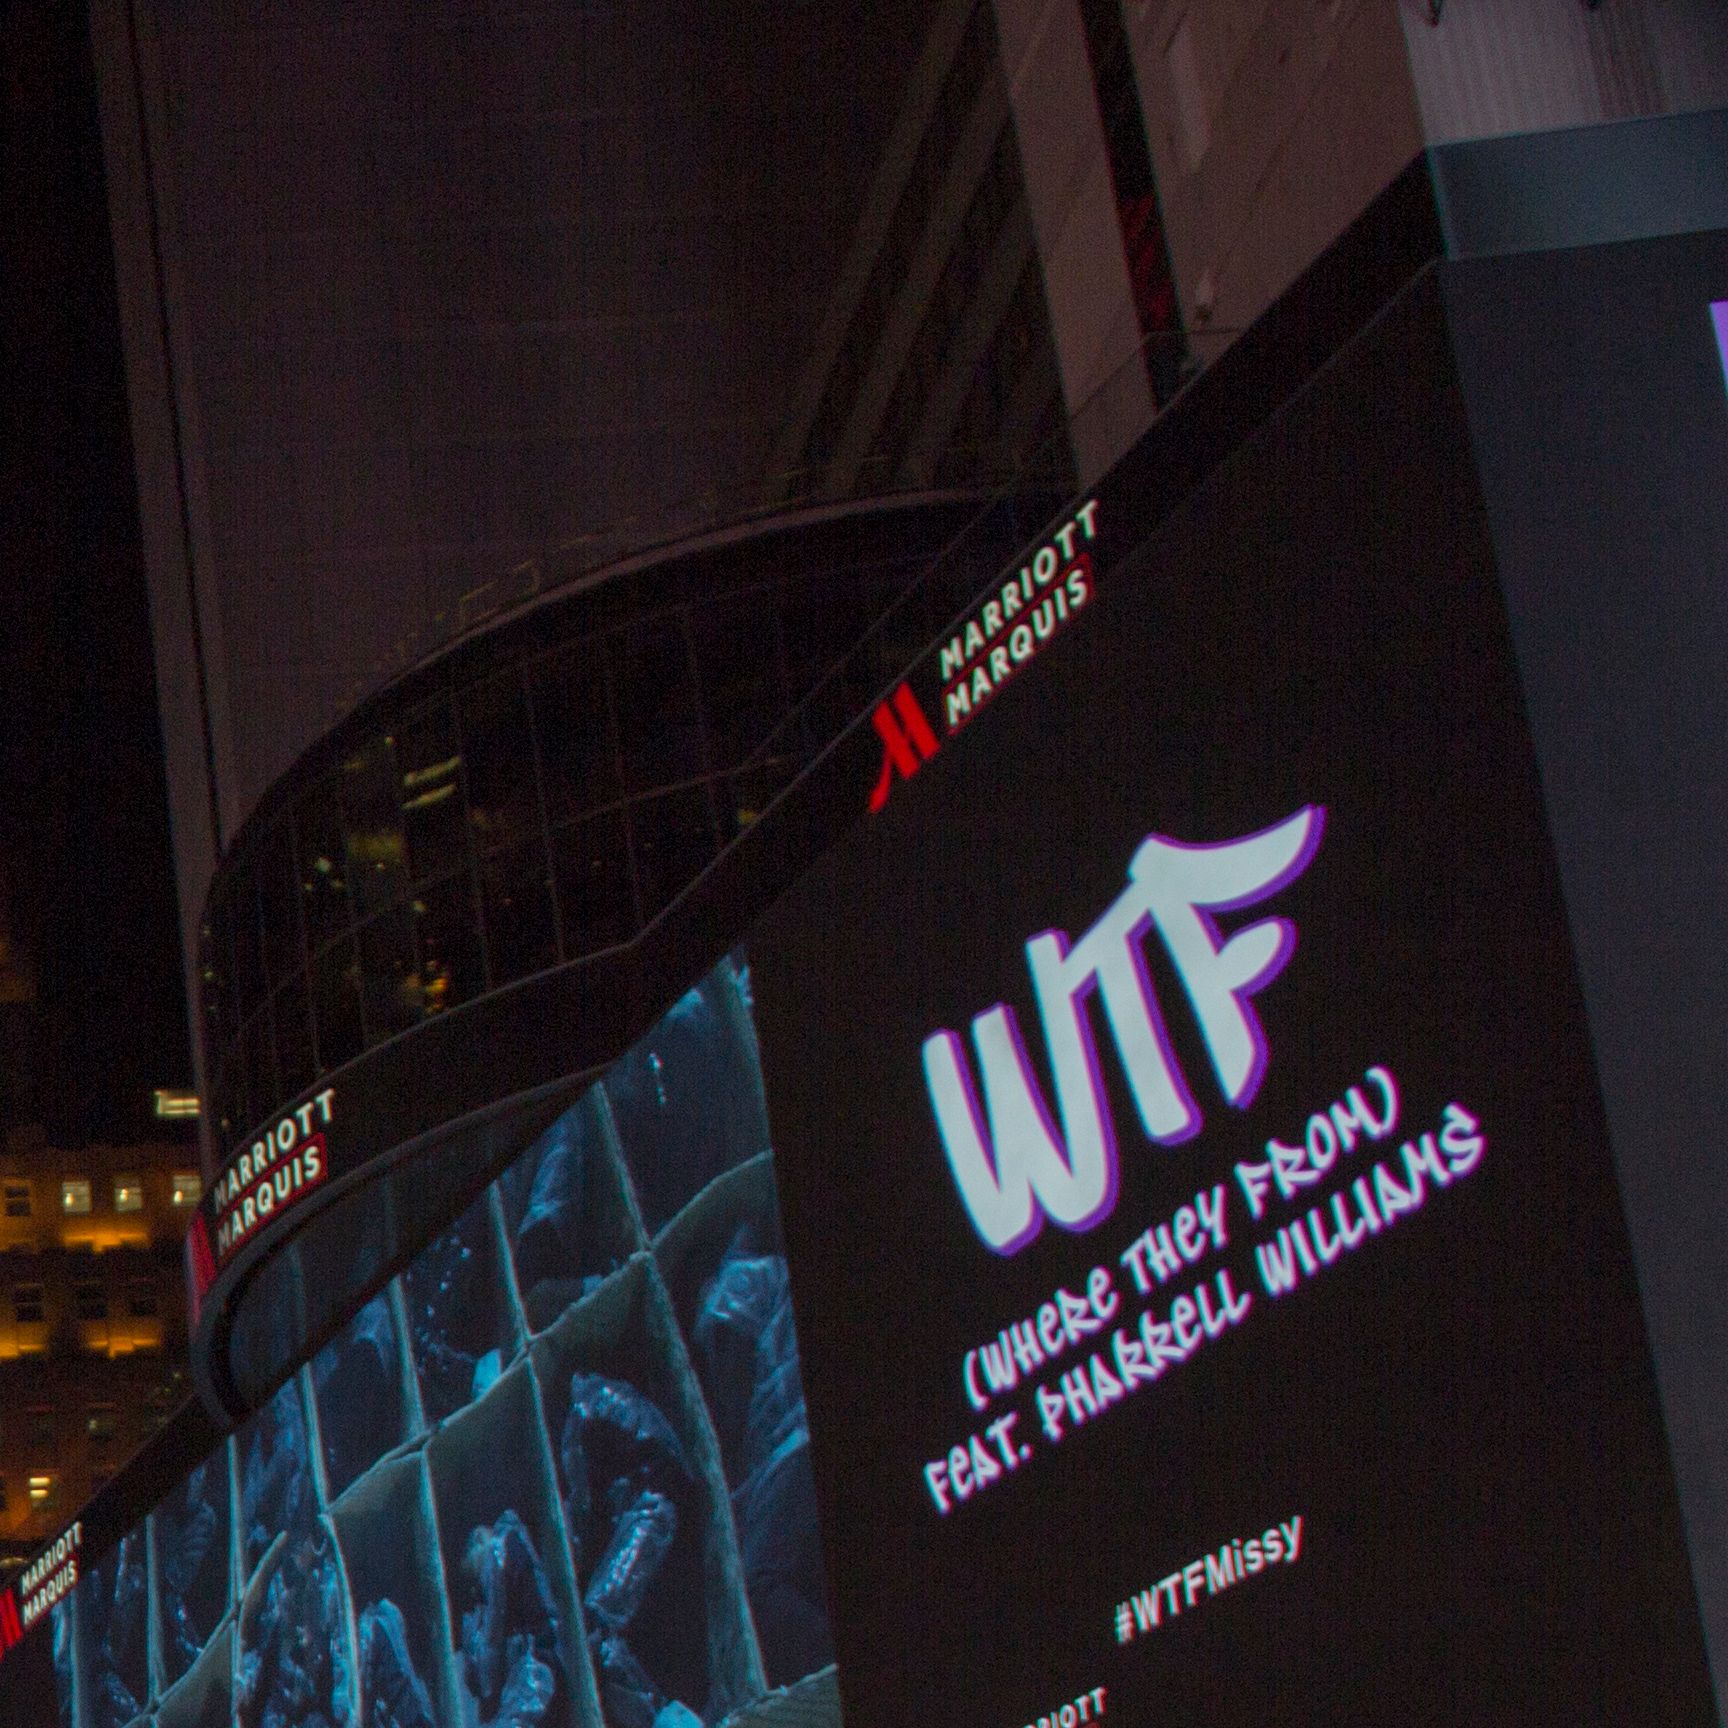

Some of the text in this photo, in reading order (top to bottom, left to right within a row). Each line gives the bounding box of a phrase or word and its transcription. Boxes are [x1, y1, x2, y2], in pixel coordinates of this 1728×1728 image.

[938, 500, 1100, 681] MARRIOTT
[945, 567, 1091, 728] MARQUIS
[922, 804, 1326, 1256] WTF
[213, 1087, 335, 1215] MARRIOTT
[216, 1143, 325, 1258] MARQUIS
[1255, 1101, 1487, 1298] WILLIAMS
[19, 1521, 84, 1595] MARRIOTT
[21, 1558, 79, 1627] MARQUIS
[1113, 1514, 1304, 1646] #WTFMissy
